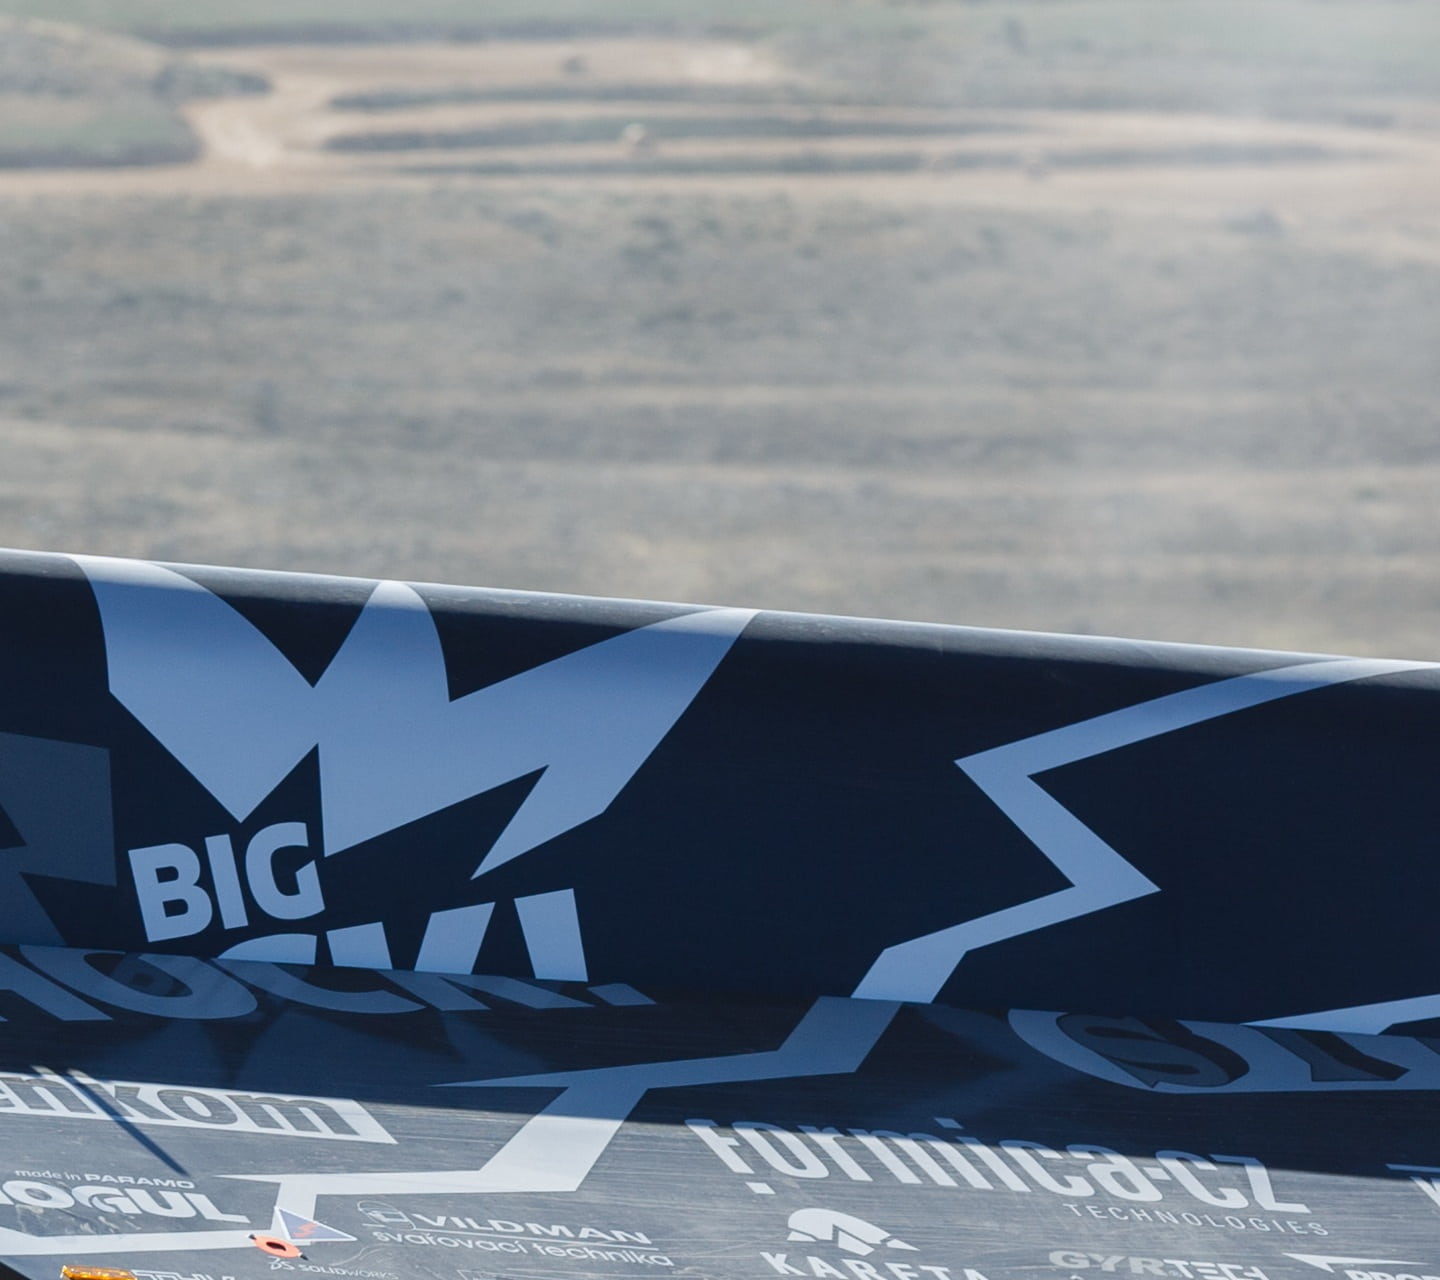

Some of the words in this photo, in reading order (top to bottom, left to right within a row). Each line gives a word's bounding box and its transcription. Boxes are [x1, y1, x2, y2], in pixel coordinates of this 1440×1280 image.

[128, 821, 326, 943] BIG
[13, 1169, 62, 1181] made
[64, 1170, 81, 1182] in
[83, 1173, 196, 1190] PARAMO
[411, 1212, 653, 1246] VILDMAN
[1062, 1202, 1330, 1238] TECHNOLOGIES
[372, 1230, 529, 1256] svařovací
[531, 1240, 676, 1268] technika
[298, 1263, 400, 1280] SOLIDWORKS
